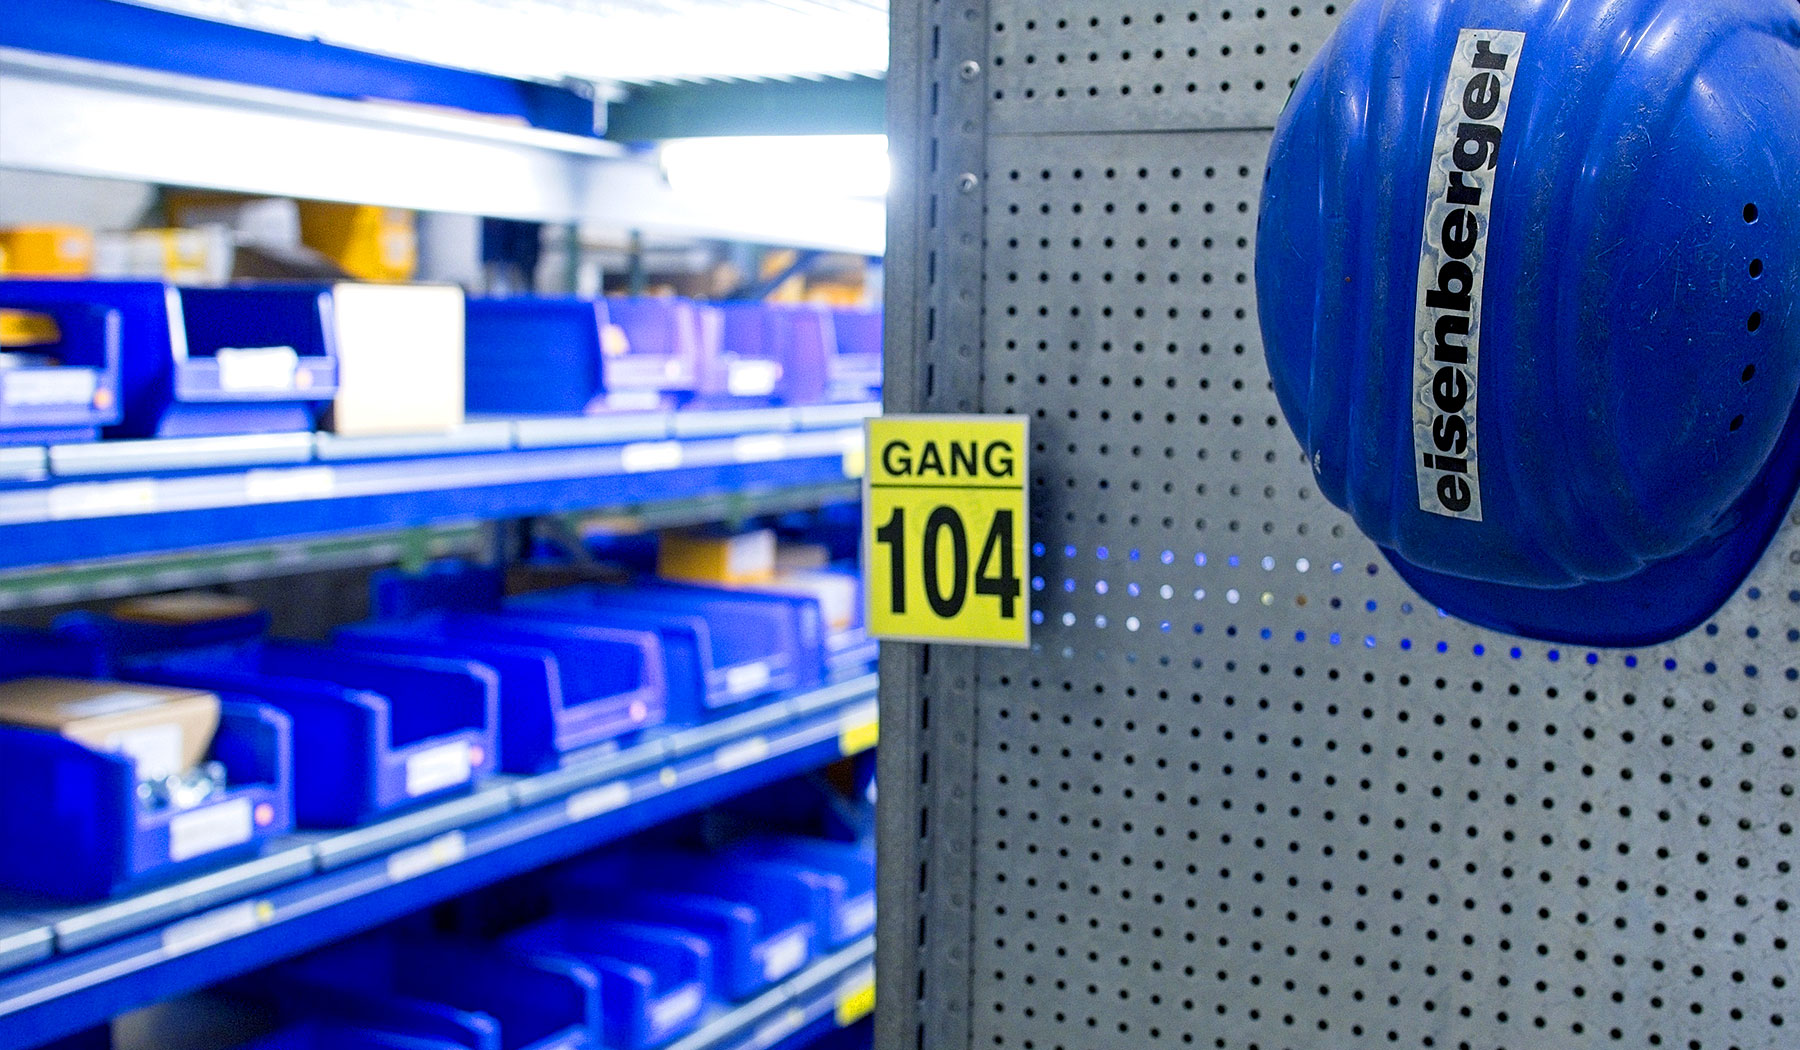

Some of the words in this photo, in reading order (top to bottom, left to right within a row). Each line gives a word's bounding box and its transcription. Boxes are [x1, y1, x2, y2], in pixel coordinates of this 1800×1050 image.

[1423, 39, 1508, 513] eisenberger
[883, 440, 1014, 478] GANG
[877, 505, 1020, 619] 104
